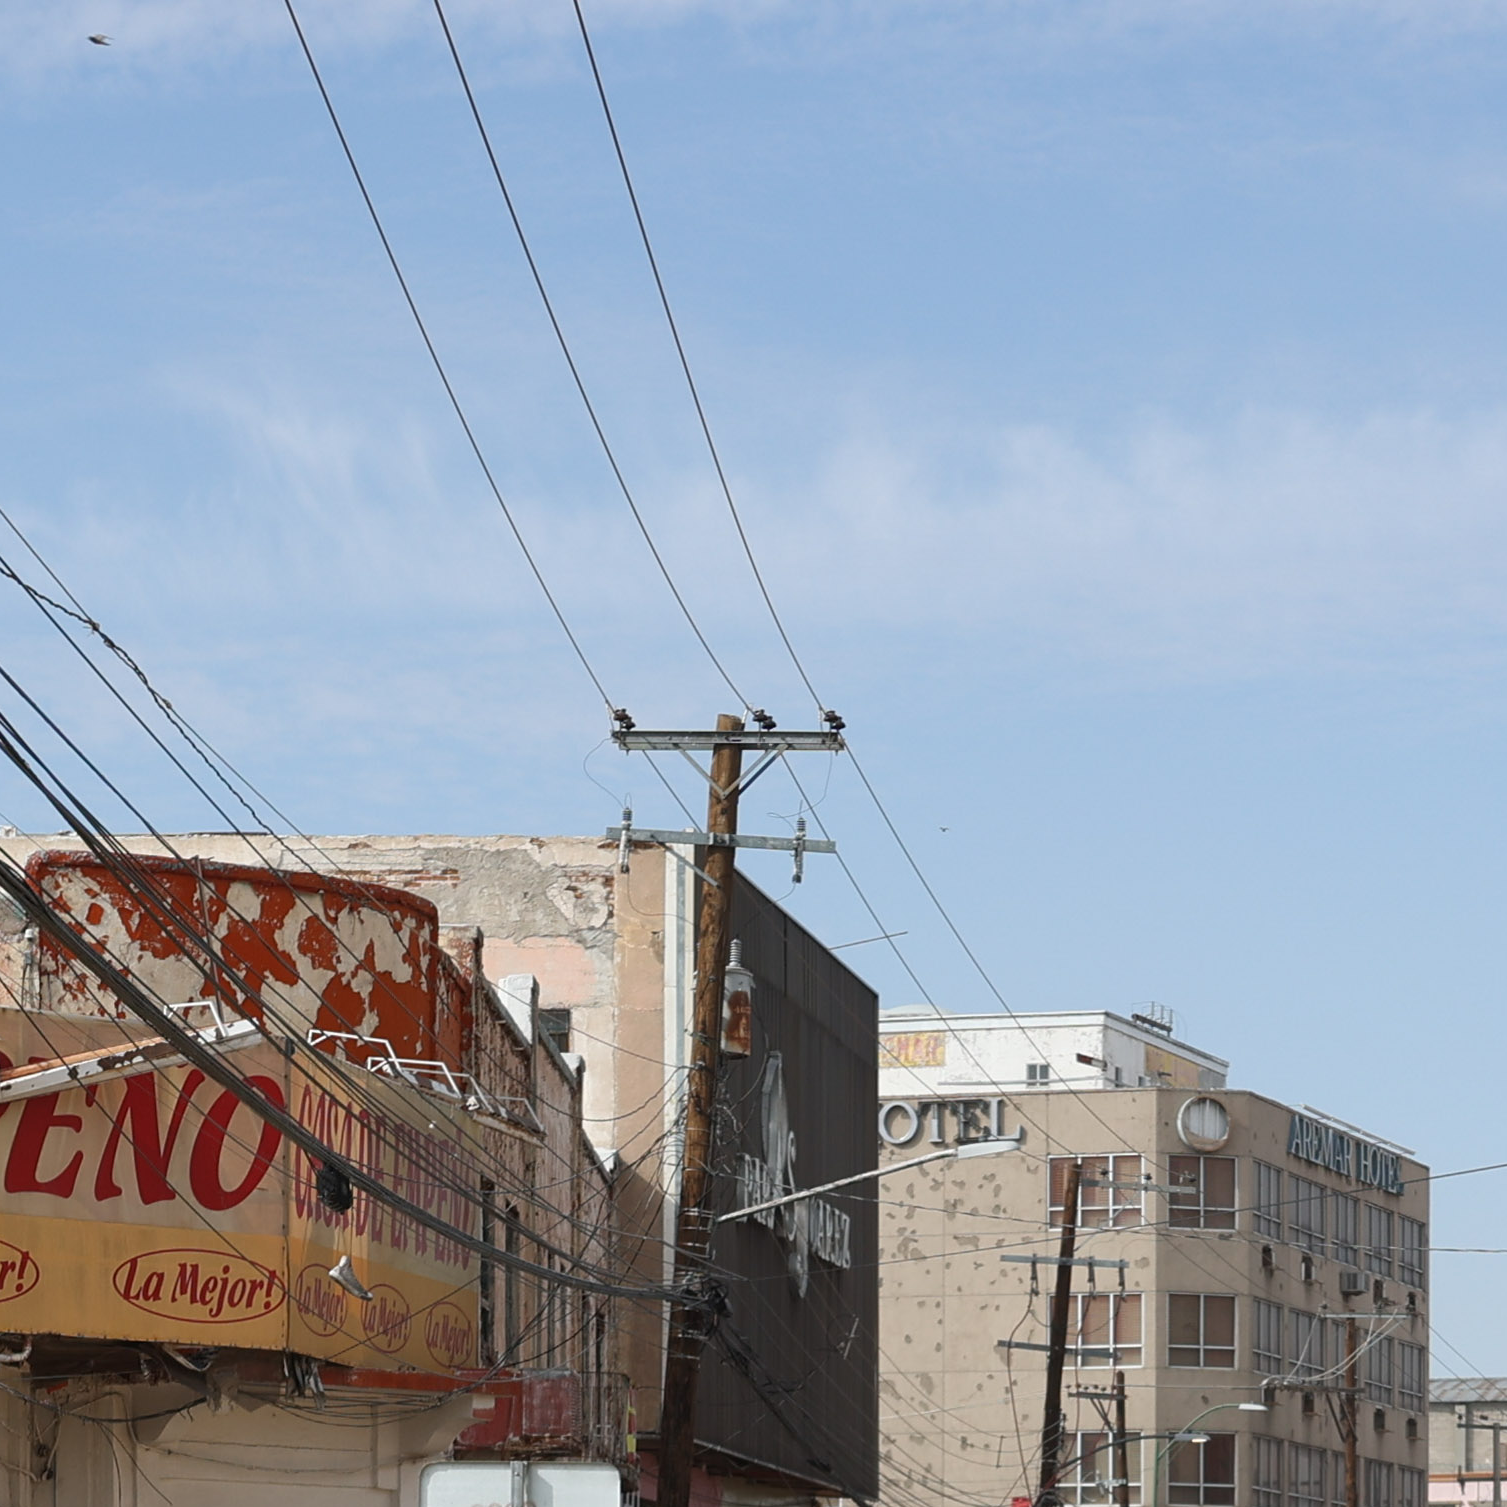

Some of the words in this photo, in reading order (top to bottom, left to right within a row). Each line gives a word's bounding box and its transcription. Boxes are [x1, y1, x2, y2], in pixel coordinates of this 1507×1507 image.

[879, 1098, 1022, 1145] OTEL
[1291, 1114, 1352, 1177] AREMAR
[123, 1258, 165, 1302] La
[171, 1262, 277, 1319] Mejor!
[298, 1273, 311, 1315] La
[427, 1309, 440, 1351] La
